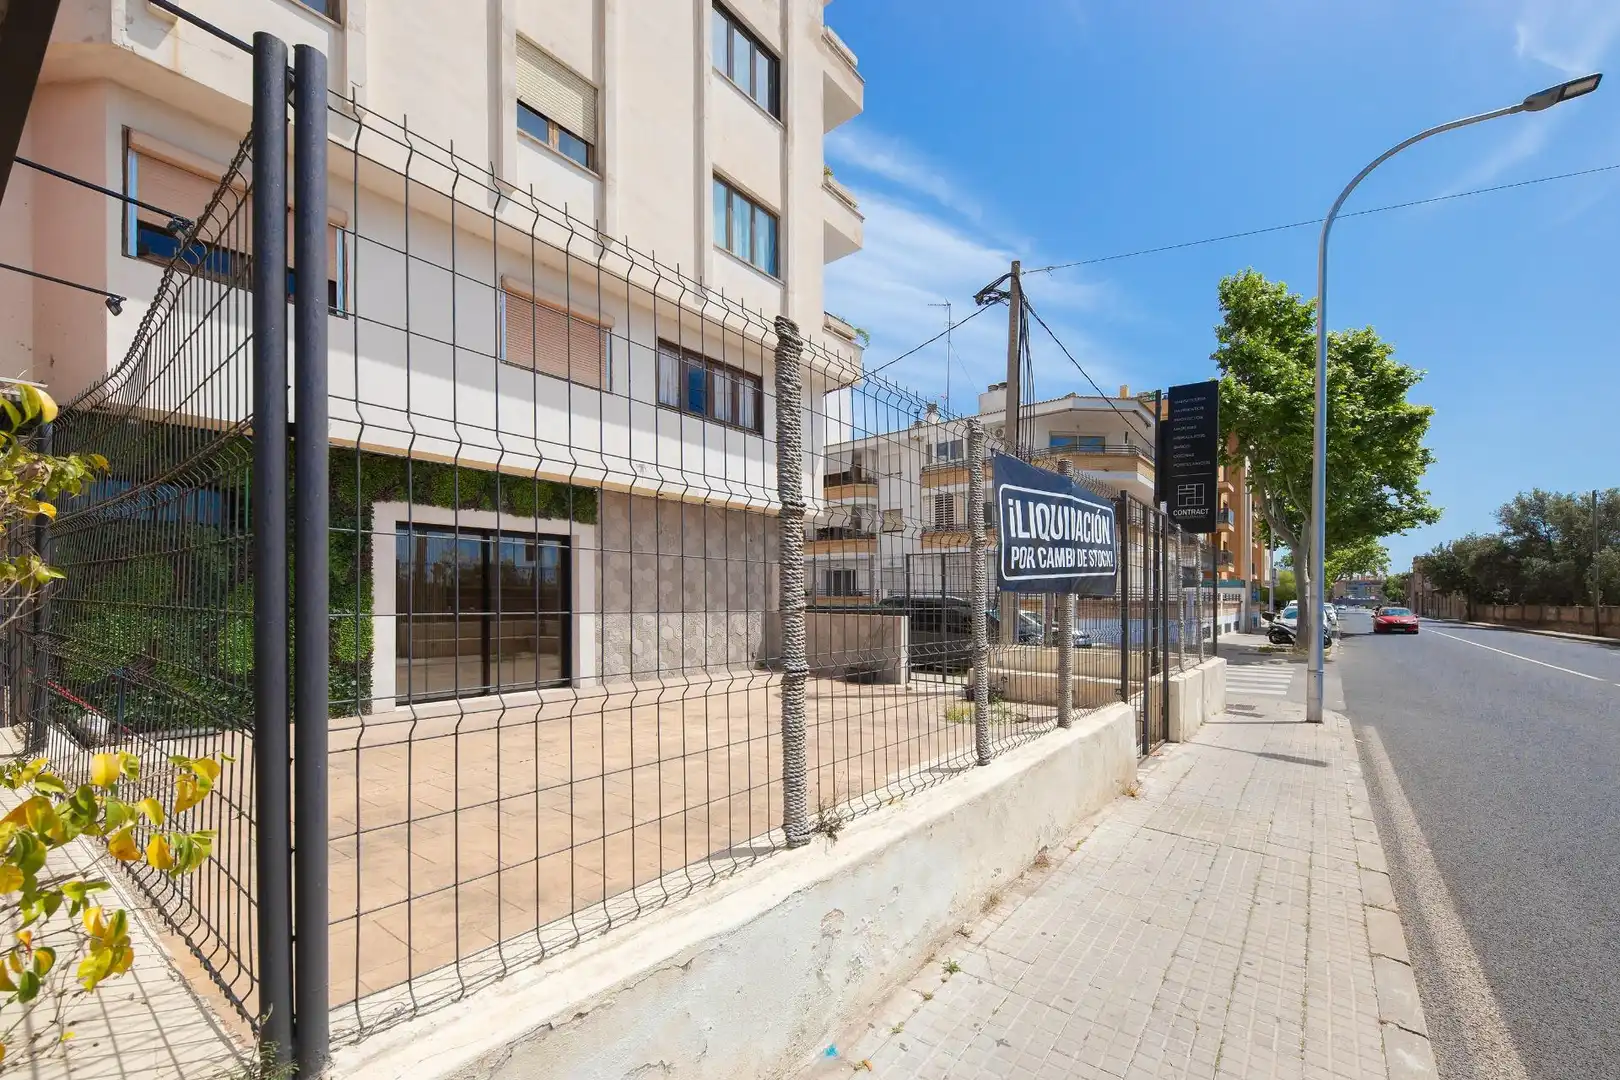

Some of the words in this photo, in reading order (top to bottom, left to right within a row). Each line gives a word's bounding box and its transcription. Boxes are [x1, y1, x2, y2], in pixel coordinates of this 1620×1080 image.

[1172, 508, 1209, 516] CONTRACT
[1011, 546, 1036, 569] POR
[1077, 548, 1088, 567] DE
